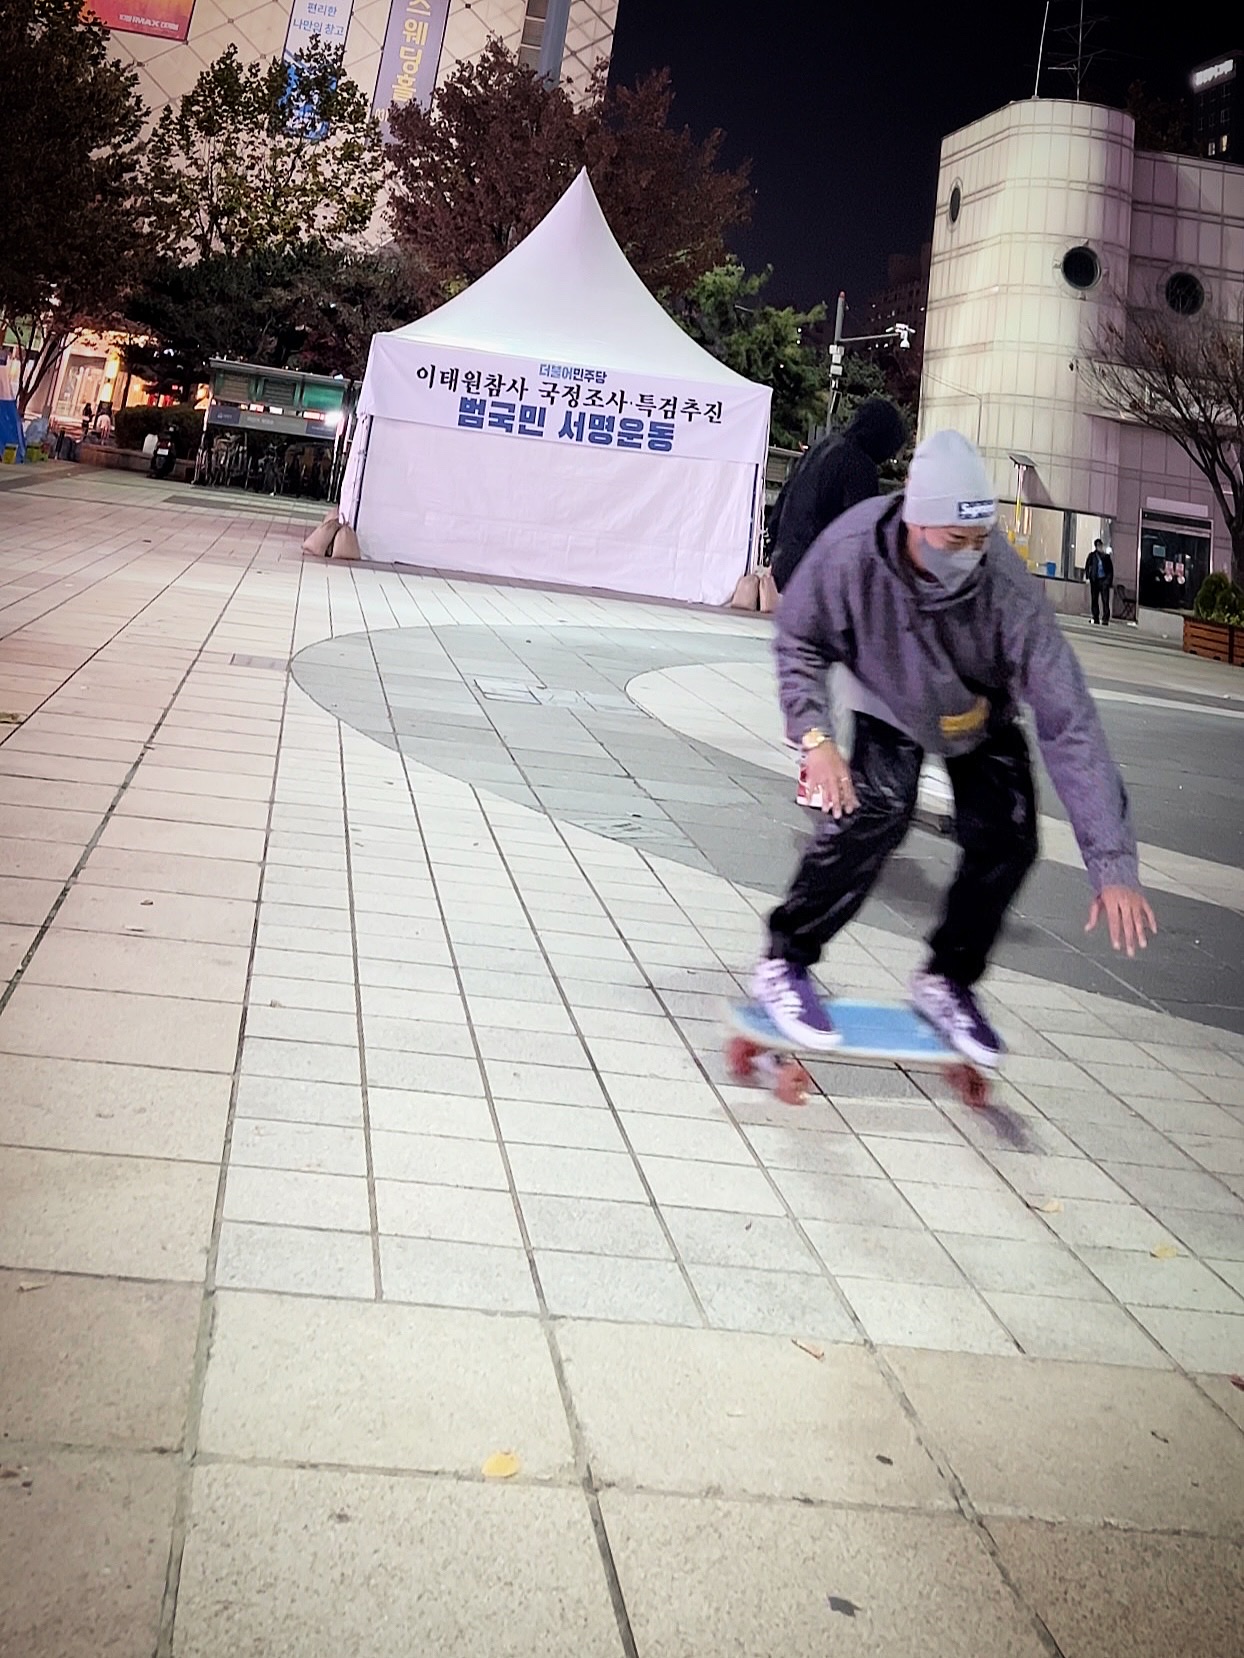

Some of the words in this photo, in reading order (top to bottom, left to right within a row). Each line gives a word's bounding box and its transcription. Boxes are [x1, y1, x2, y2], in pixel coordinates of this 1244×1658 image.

[307, 2, 337, 17] 편리한
[293, 18, 323, 33] 나만의
[325, 23, 344, 36] 창고
[416, 364, 529, 402] 이태원참사
[538, 363, 608, 385] 더불어민주당
[457, 396, 547, 437] 범국민
[558, 410, 676, 452] 서명운동
